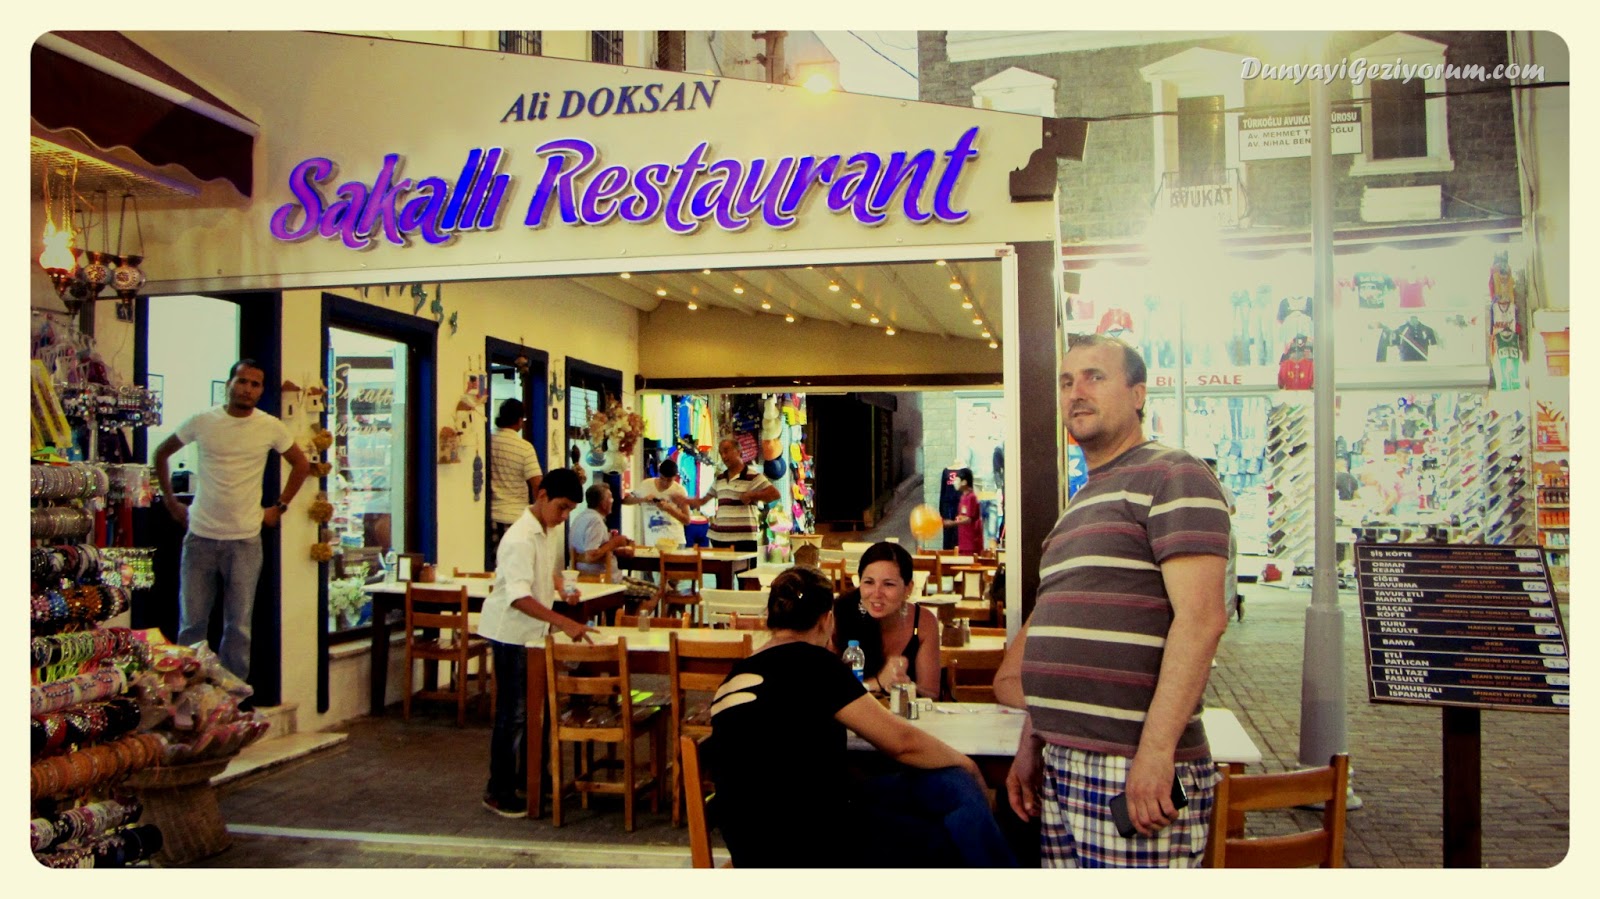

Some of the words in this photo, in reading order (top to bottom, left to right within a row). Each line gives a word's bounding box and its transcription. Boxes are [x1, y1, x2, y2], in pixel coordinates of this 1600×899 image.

[500, 92, 550, 122] Ali
[556, 80, 720, 119] DOKSAN
[1243, 116, 1282, 128] TÜRKOĞLU
[1284, 115, 1312, 125] AVUKAT
[1331, 112, 1357, 122] ÜROSU
[1263, 130, 1301, 138] MEHMET
[270, 147, 511, 250] Sakallı
[523, 125, 979, 235] Restaurant
[1170, 187, 1232, 208] AVUKAT
[1198, 374, 1243, 386] SALE
[1405, 669, 1428, 677] TAZE
[1385, 675, 1424, 683] FASULYE
[1388, 684, 1442, 693] YUMURTALI
[1389, 690, 1431, 699] ISPANAK
